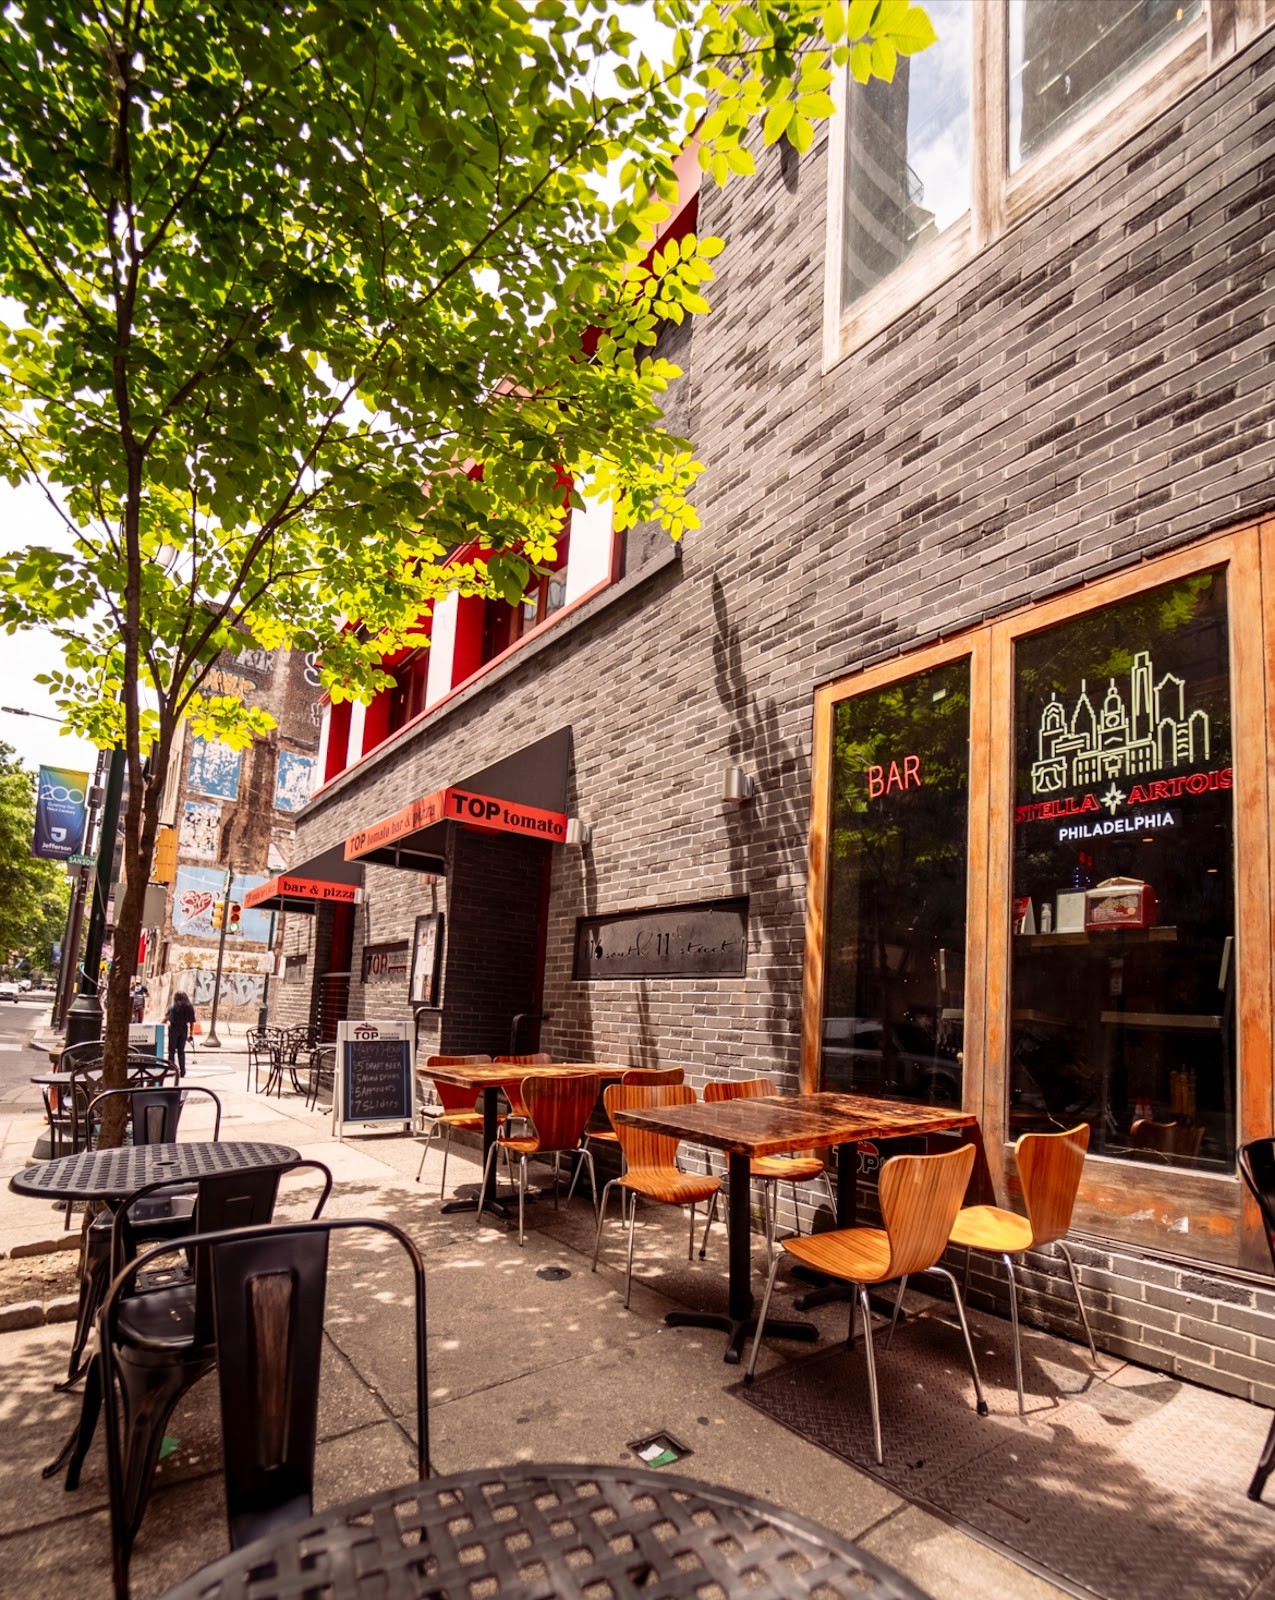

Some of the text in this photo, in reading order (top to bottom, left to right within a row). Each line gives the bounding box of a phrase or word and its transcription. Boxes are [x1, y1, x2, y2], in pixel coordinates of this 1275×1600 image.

[868, 755, 921, 798] BAR
[40, 784, 84, 804] 200
[1015, 767, 1233, 824] STELLA ARTOIS
[451, 793, 563, 836] TOP tomato
[1059, 812, 1174, 841] PHILADELPHIA
[350, 804, 436, 853] TOP tomato bar & pizza
[42, 842, 72, 851] Jefferson
[283, 881, 355, 899] bar & pizza
[606, 930, 653, 959] south
[680, 939, 739, 955] street
[367, 953, 388, 975] TOP
[353, 1031, 379, 1040] TOP
[365, 1062, 384, 1071] DRAFT
[385, 1061, 402, 1071] BEER
